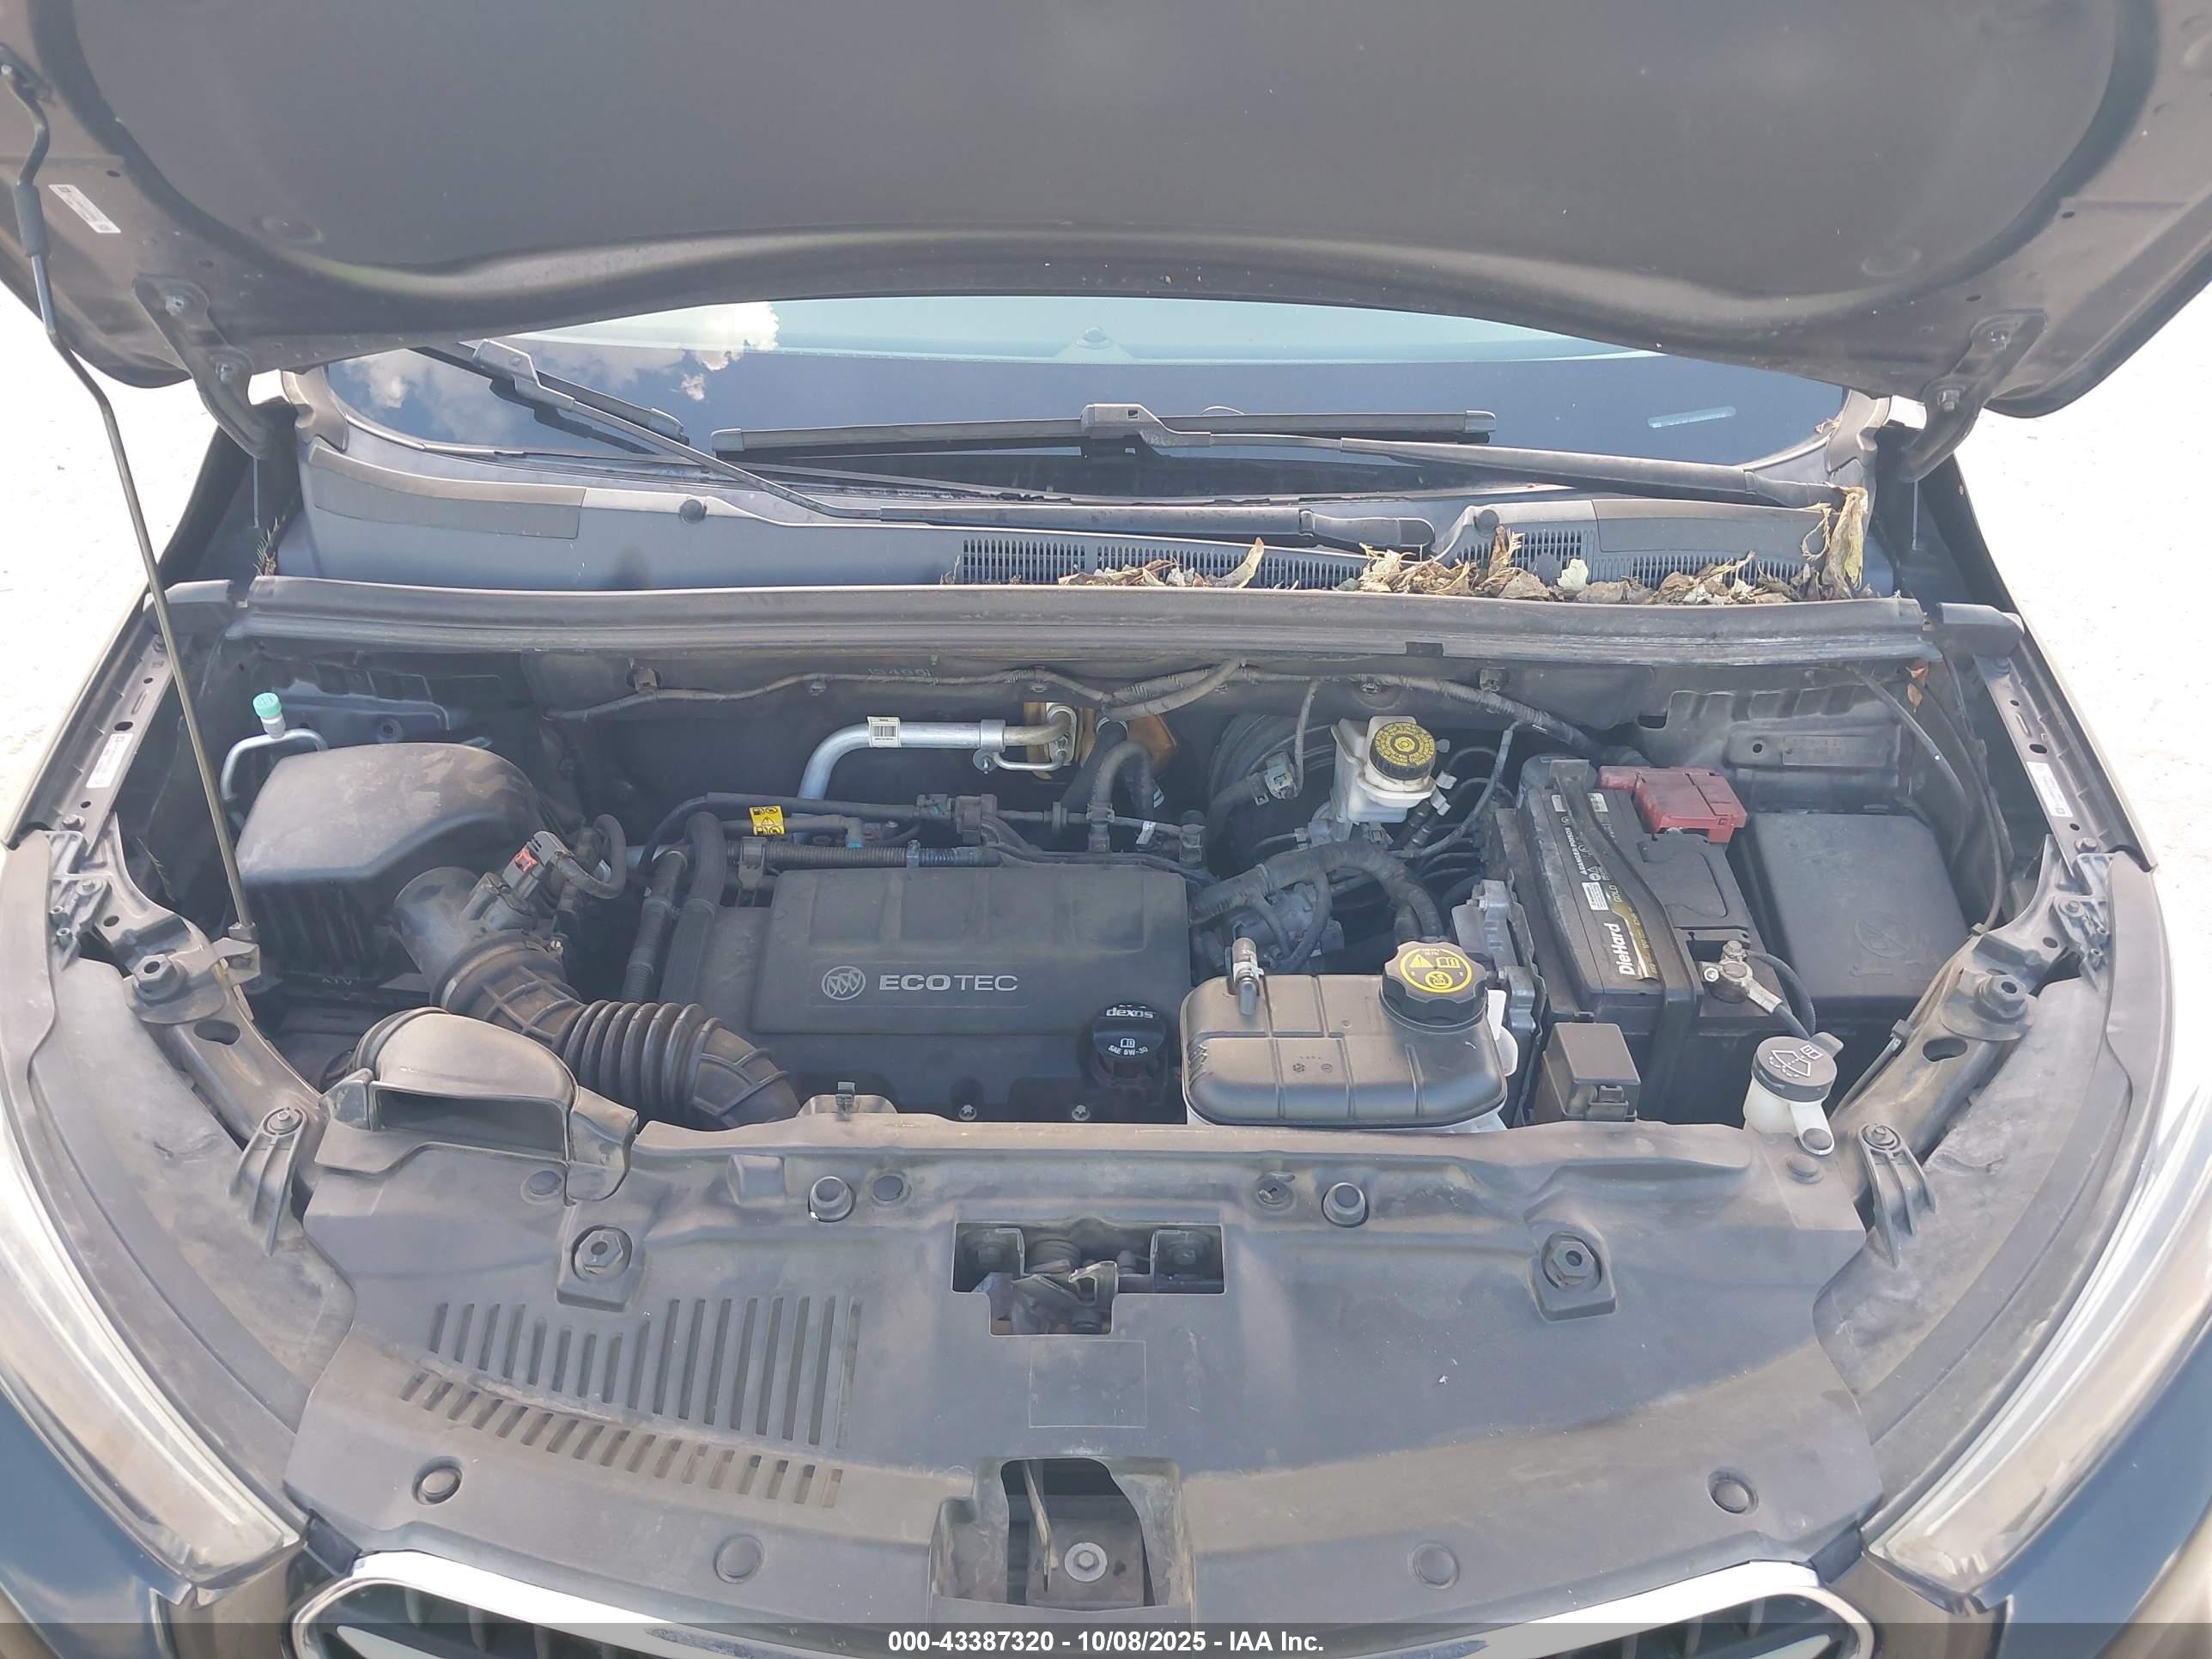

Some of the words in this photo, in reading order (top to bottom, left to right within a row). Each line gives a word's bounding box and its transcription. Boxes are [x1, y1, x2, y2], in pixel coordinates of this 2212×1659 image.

[1608, 885, 1621, 902] GOLD
[1603, 922, 1636, 975] DieHard
[878, 974, 1018, 992] ECOTEC
[1106, 1007, 1154, 1018] dexos
[1108, 1044, 1121, 1054] SAE
[1123, 1046, 1148, 1055] 5W-30
